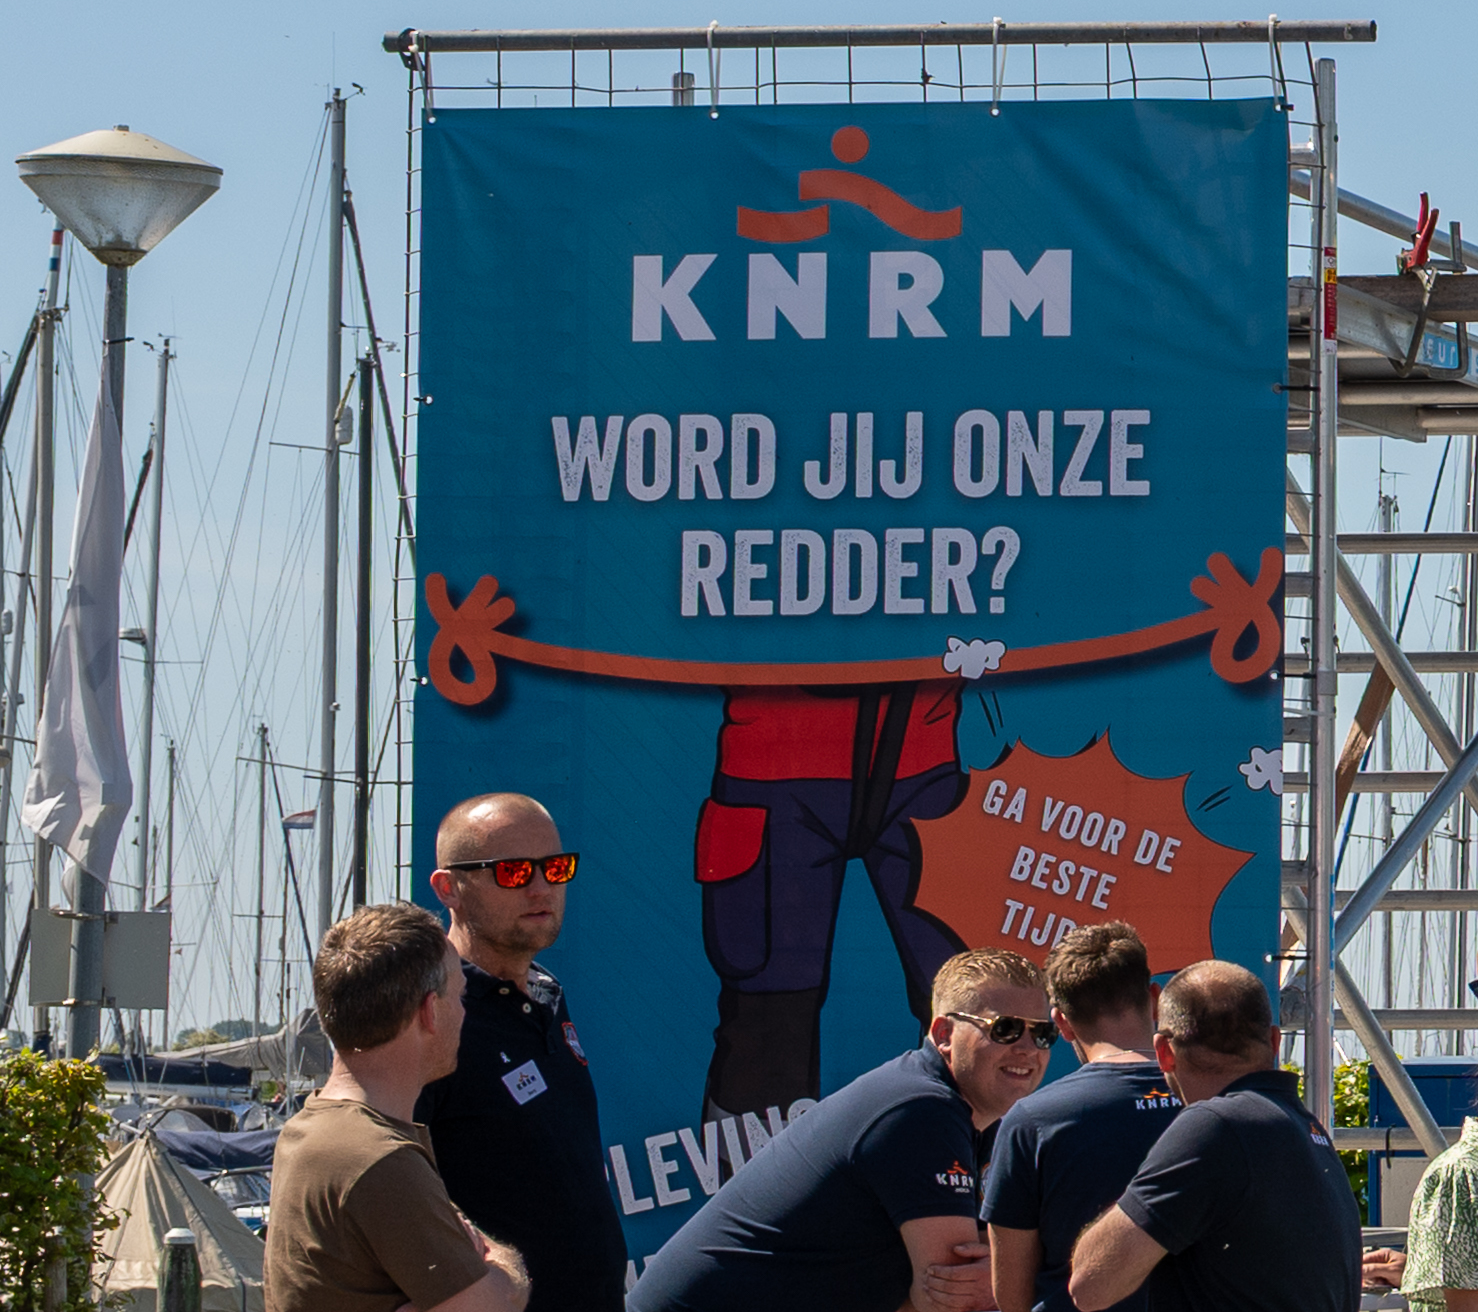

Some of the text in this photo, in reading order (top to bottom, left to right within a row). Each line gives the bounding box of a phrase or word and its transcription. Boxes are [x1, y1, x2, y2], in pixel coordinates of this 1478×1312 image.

[632, 248, 1073, 342] KNRM
[552, 408, 1151, 502] WORD JIJ ONZE
[680, 525, 1021, 617] REDDER?
[982, 779, 1182, 874] GA VOOR DE
[1009, 845, 1118, 911] BESTE
[605, 1097, 820, 1216] LEVIN
